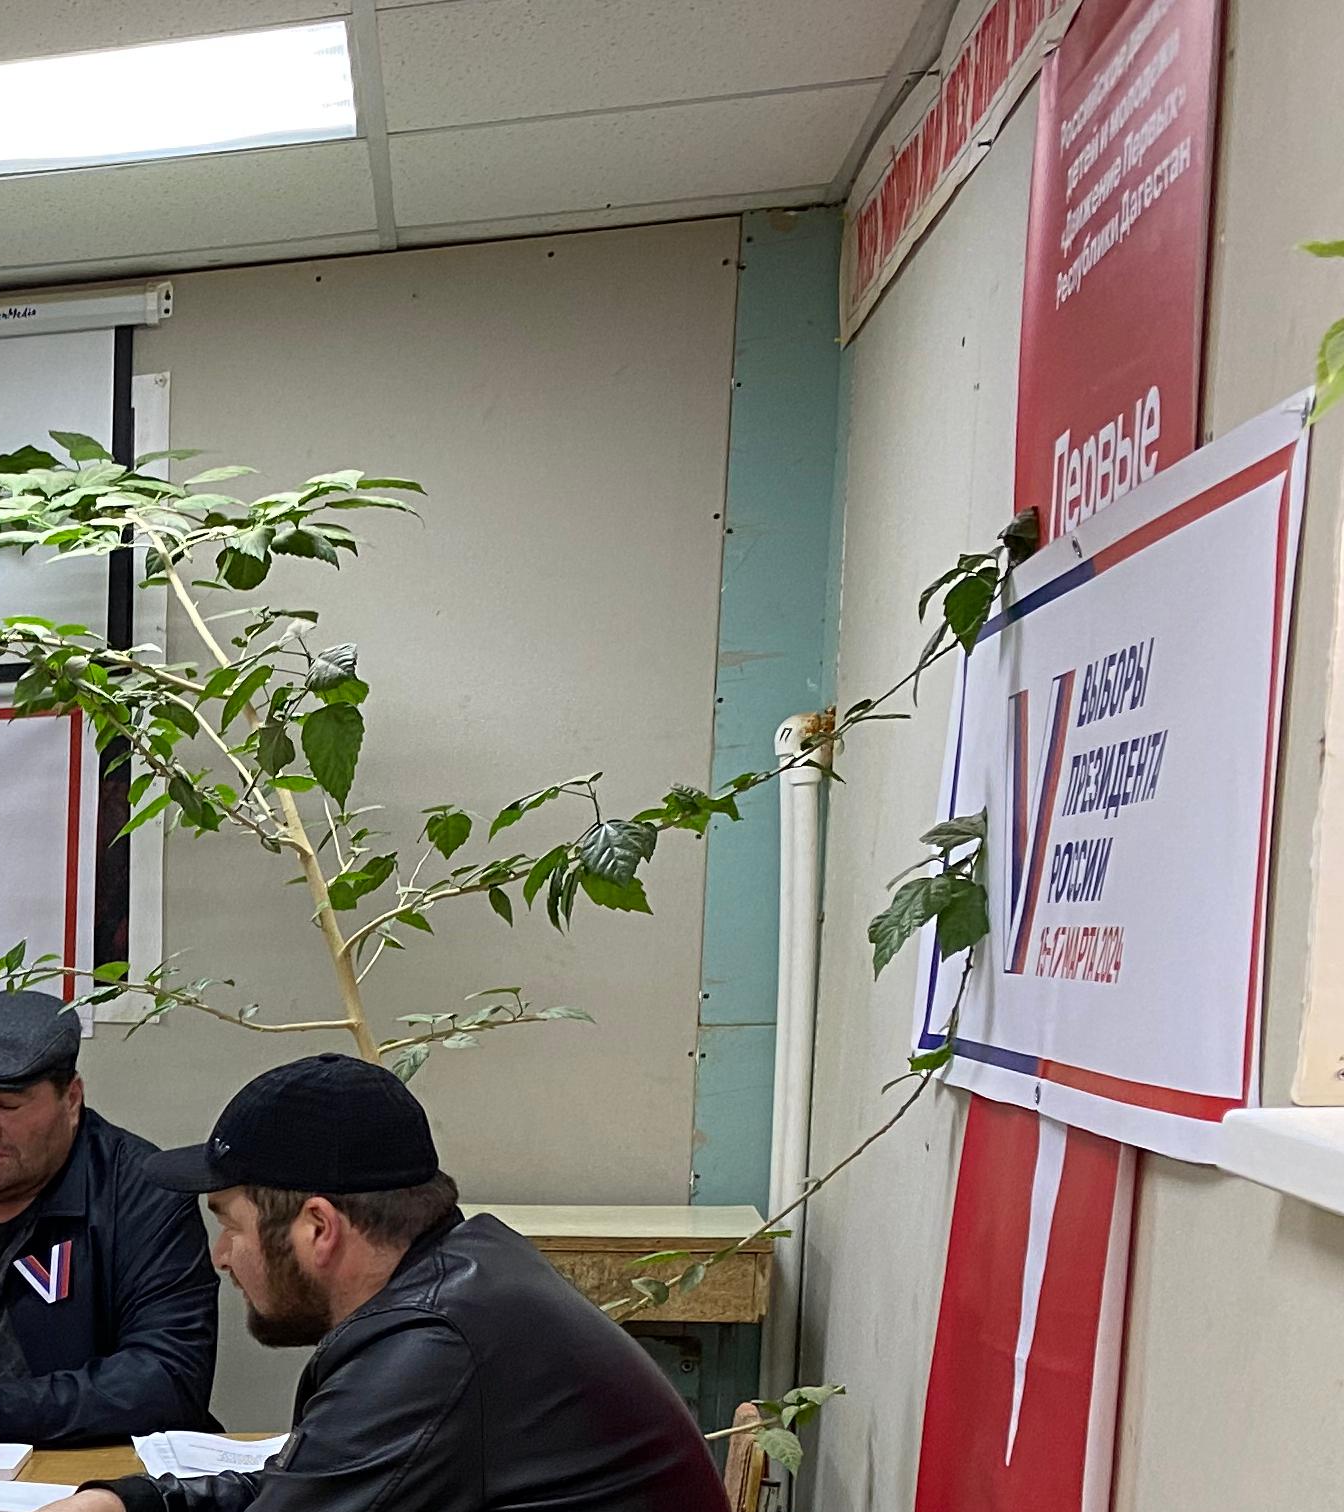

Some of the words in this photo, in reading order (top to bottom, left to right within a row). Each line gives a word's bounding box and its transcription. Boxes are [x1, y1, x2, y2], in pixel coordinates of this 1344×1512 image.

[1119, 133, 1192, 244] Дагестан
[1049, 385, 1161, 545] Первые
[1077, 637, 1155, 728] ВЫБОРЫ
[1062, 730, 1169, 820] ПРЕЗИДЕНТА
[1047, 837, 1114, 903] РОССИИ
